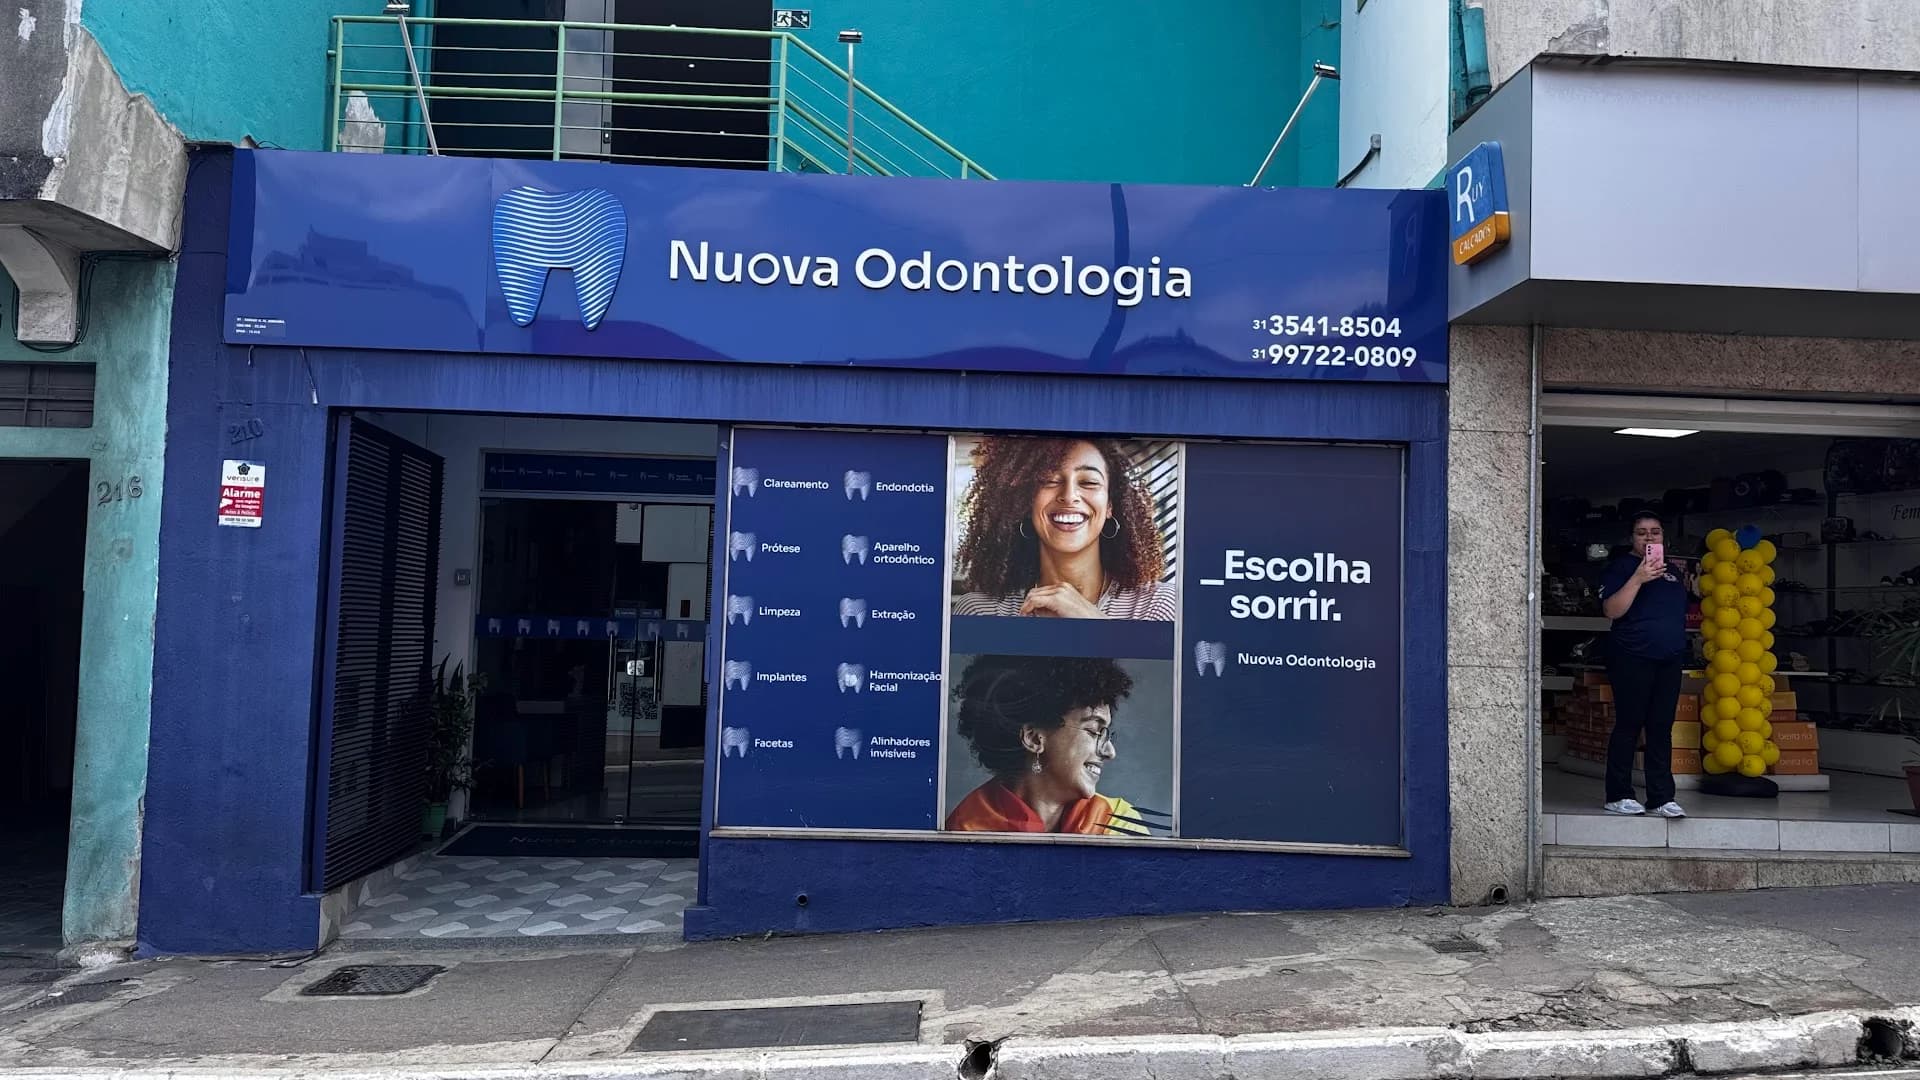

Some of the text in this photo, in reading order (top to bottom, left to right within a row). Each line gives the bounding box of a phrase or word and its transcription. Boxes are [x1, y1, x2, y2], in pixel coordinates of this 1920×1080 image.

[669, 239, 1193, 306] Nuova Odontologia
[1252, 315, 1401, 338] 31 3541-8504
[1252, 344, 1417, 368] 31 99722-0809
[228, 417, 264, 445] 210
[763, 478, 829, 490] Clareamento
[876, 482, 934, 493] Endondotia
[96, 475, 144, 507] 216
[222, 488, 261, 498] Alarme
[761, 542, 801, 554] Prótese
[873, 541, 920, 554] Aparelho
[873, 553, 935, 565] ortodôntico
[1199, 549, 1372, 586] _Escolha
[1229, 589, 1342, 622] sorrir.
[758, 606, 801, 618] Limpeza
[871, 609, 916, 621] Extração
[1237, 652, 1376, 671] Nuova Odontologia
[756, 671, 807, 683] Implantes
[869, 669, 942, 682] Harmonização
[869, 681, 898, 693] Facial
[754, 738, 794, 749] Facetas
[870, 736, 931, 747] Alinhadores
[870, 747, 916, 759] invisíveis
